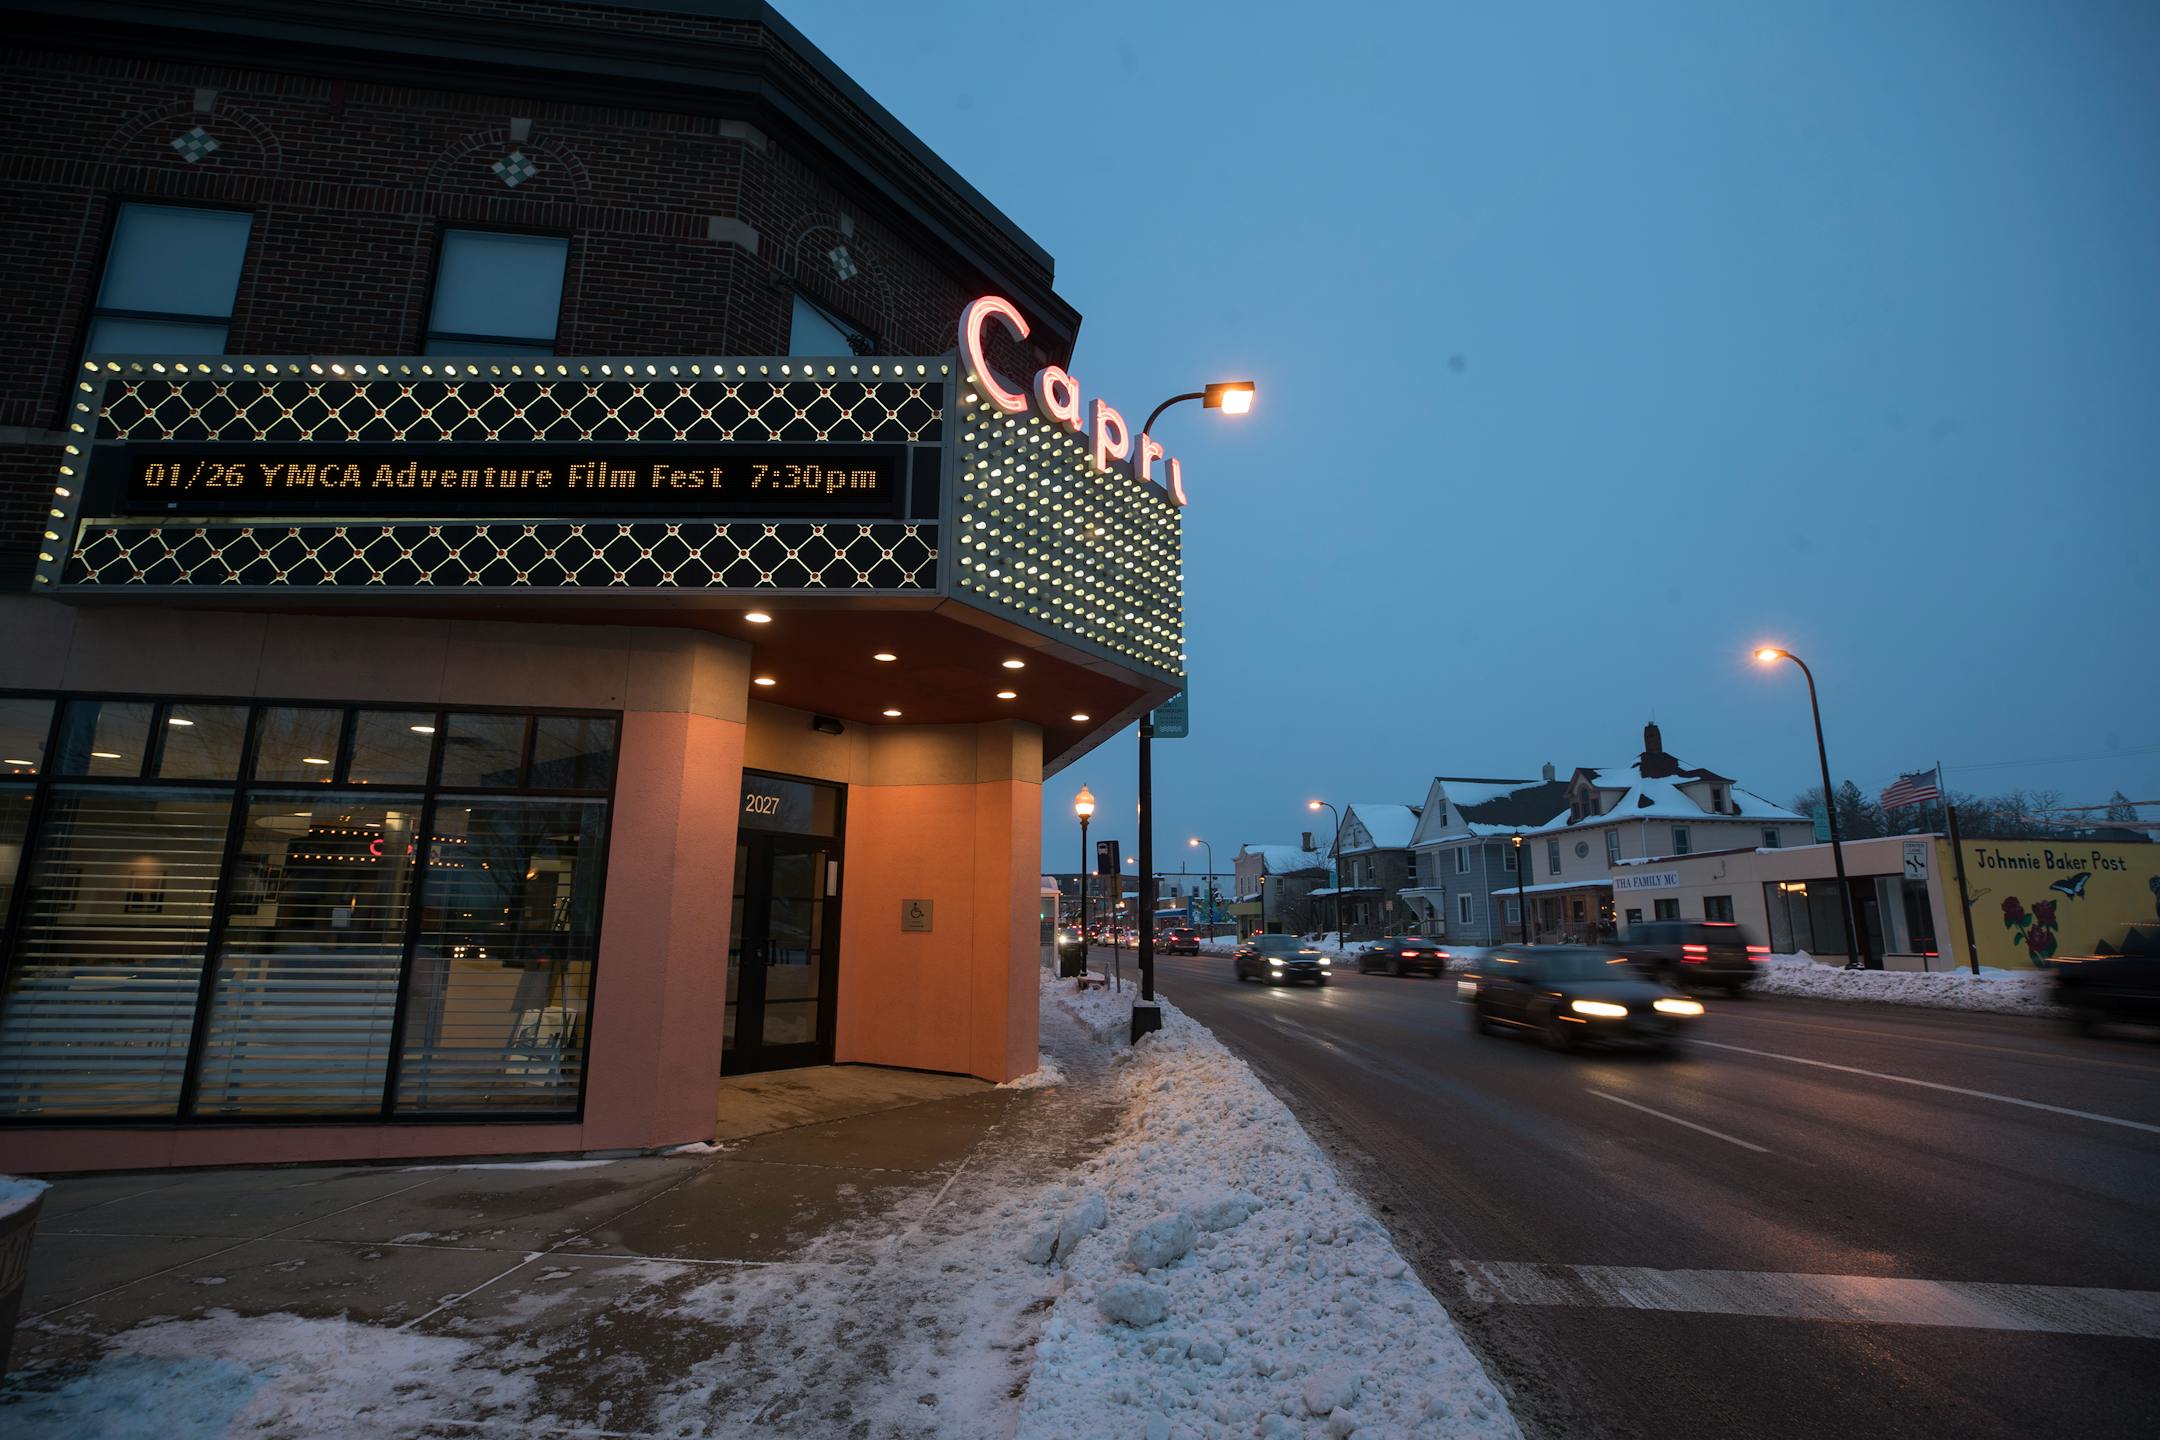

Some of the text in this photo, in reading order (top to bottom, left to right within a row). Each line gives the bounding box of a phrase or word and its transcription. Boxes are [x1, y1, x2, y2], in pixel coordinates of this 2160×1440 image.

[958, 295, 1187, 506] Capri
[145, 461, 877, 494] 01/26 YMCA Adventure Film Fest 7:30pm
[745, 794, 781, 815] 2027
[1975, 849, 2127, 871] Johnnie Baker Post
[1633, 874, 1661, 888] FAMILY
[1664, 873, 1677, 886] MC
